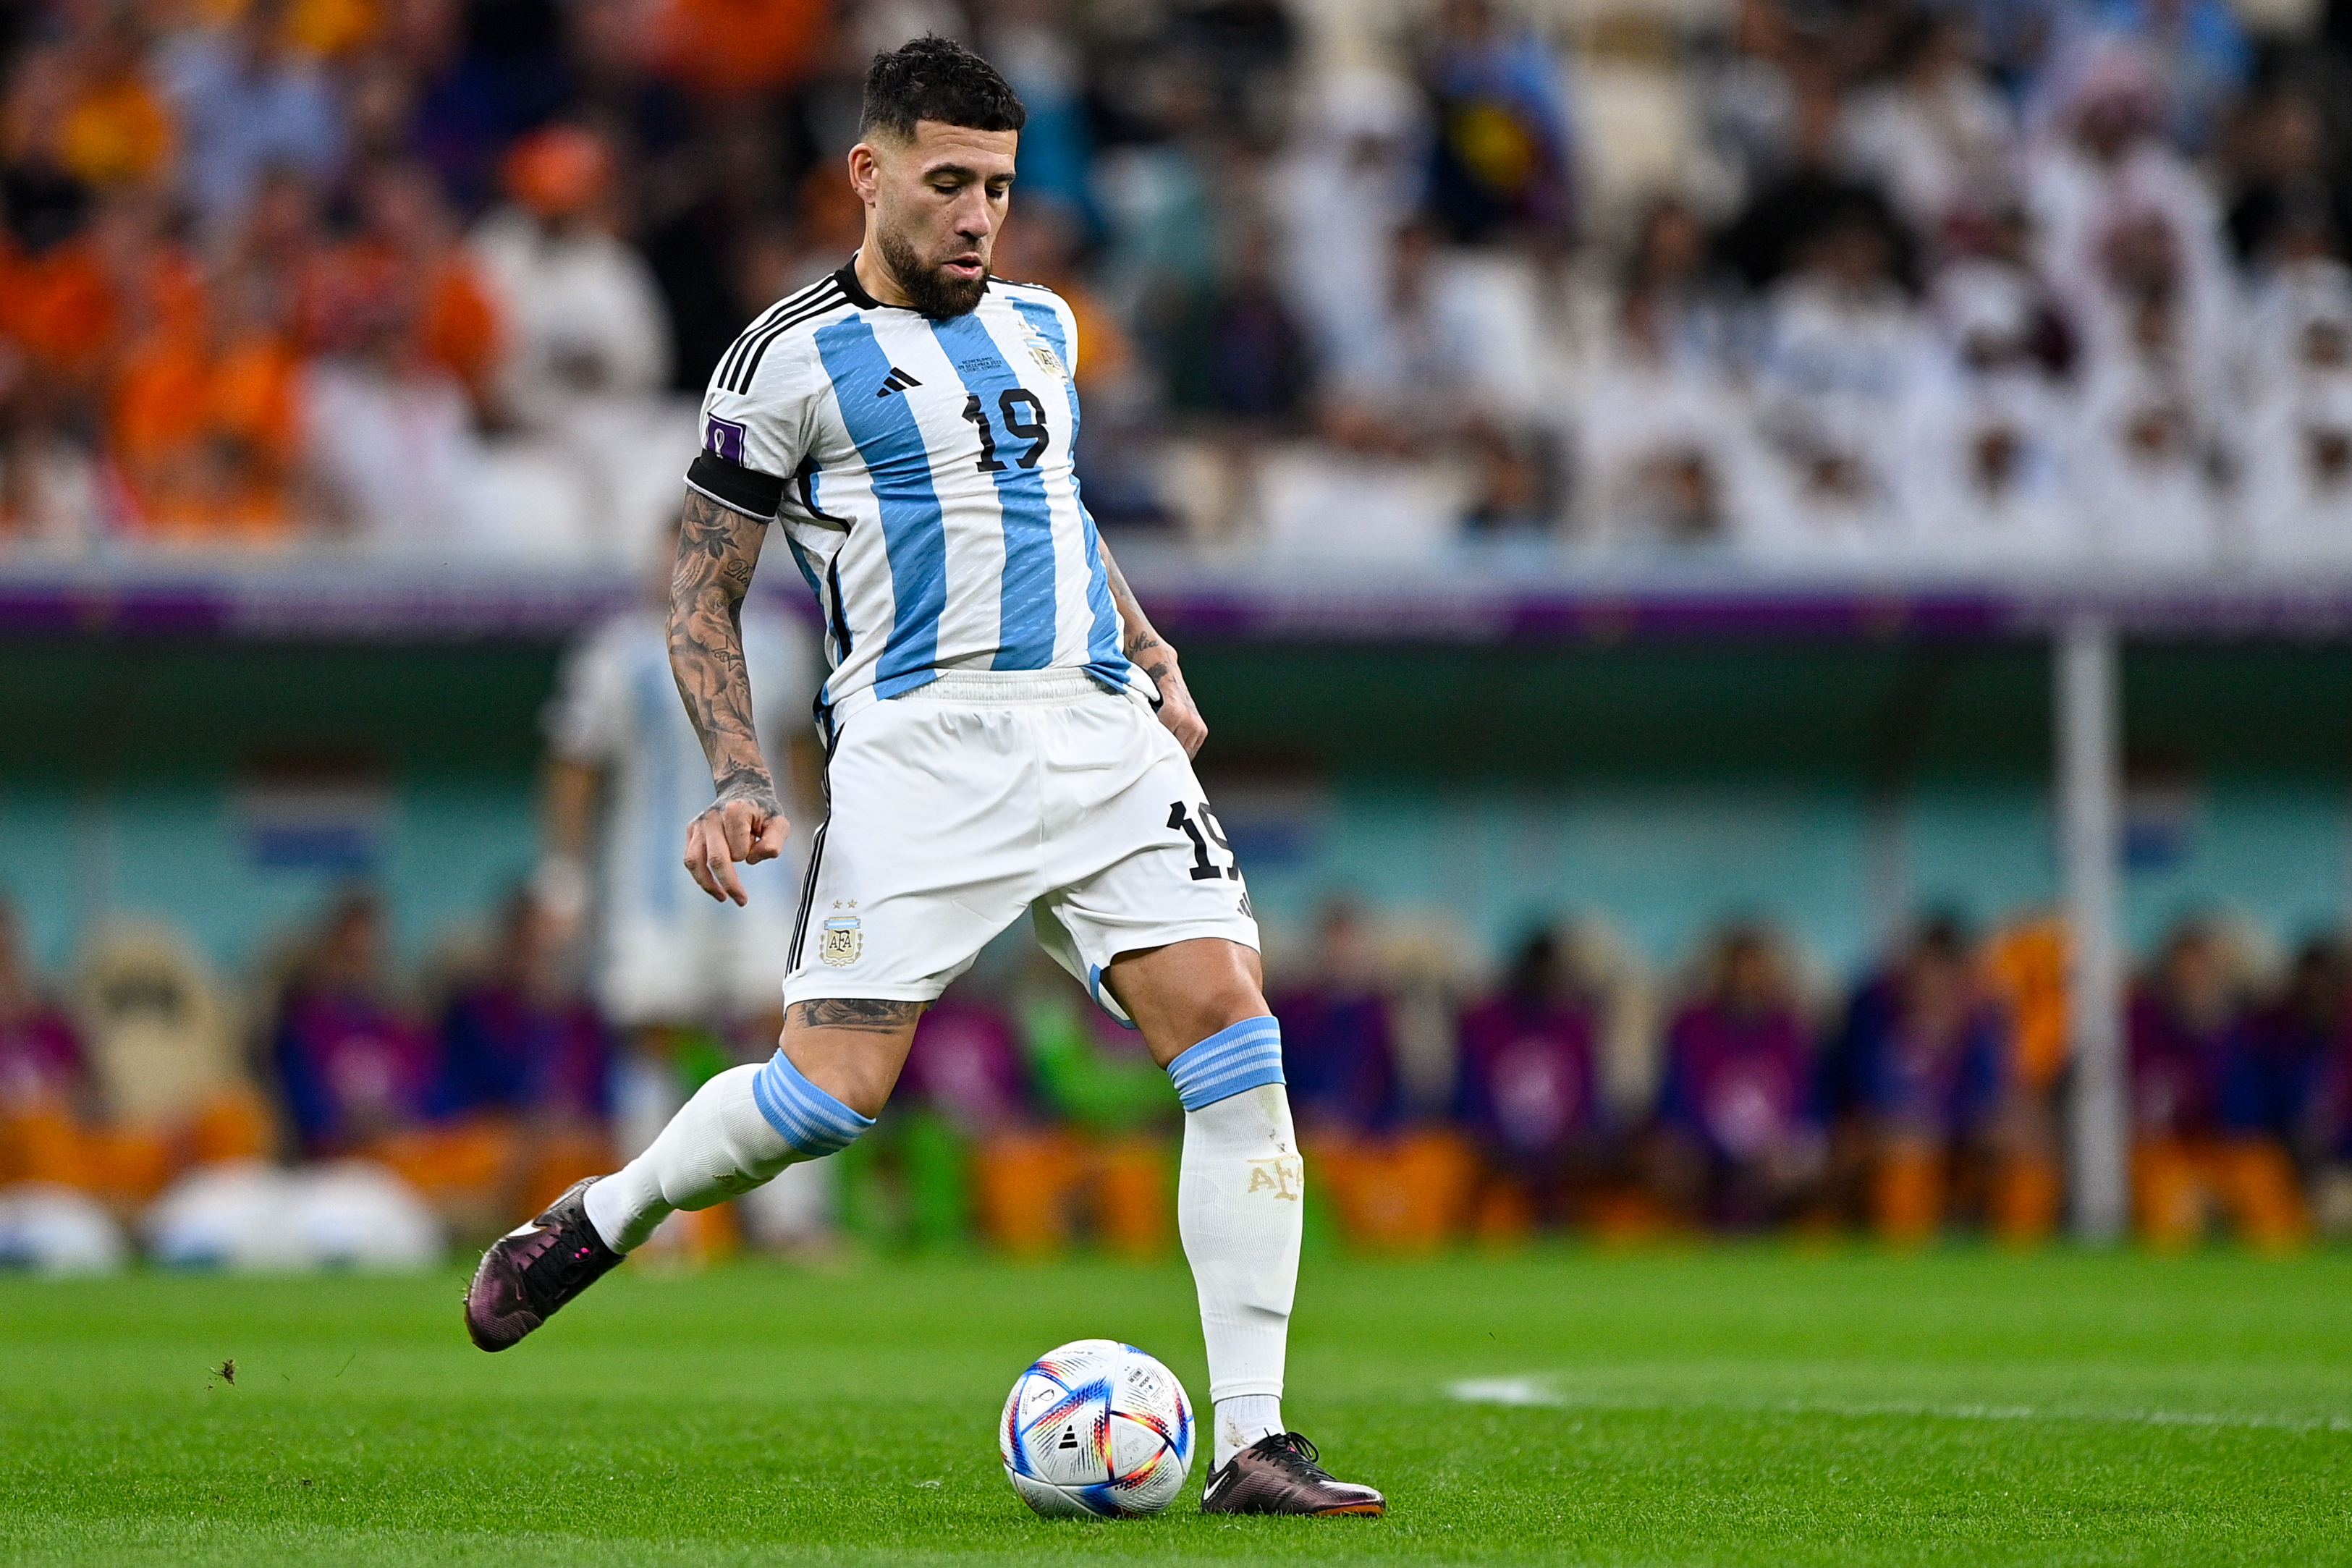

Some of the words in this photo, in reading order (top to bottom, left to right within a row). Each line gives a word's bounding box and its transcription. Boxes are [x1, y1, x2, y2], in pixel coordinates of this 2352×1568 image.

[962, 389, 1049, 472] 19
[1128, 631, 1159, 653] Mia
[829, 930, 853, 952] AFA
[1247, 1153, 1304, 1201] AFA
